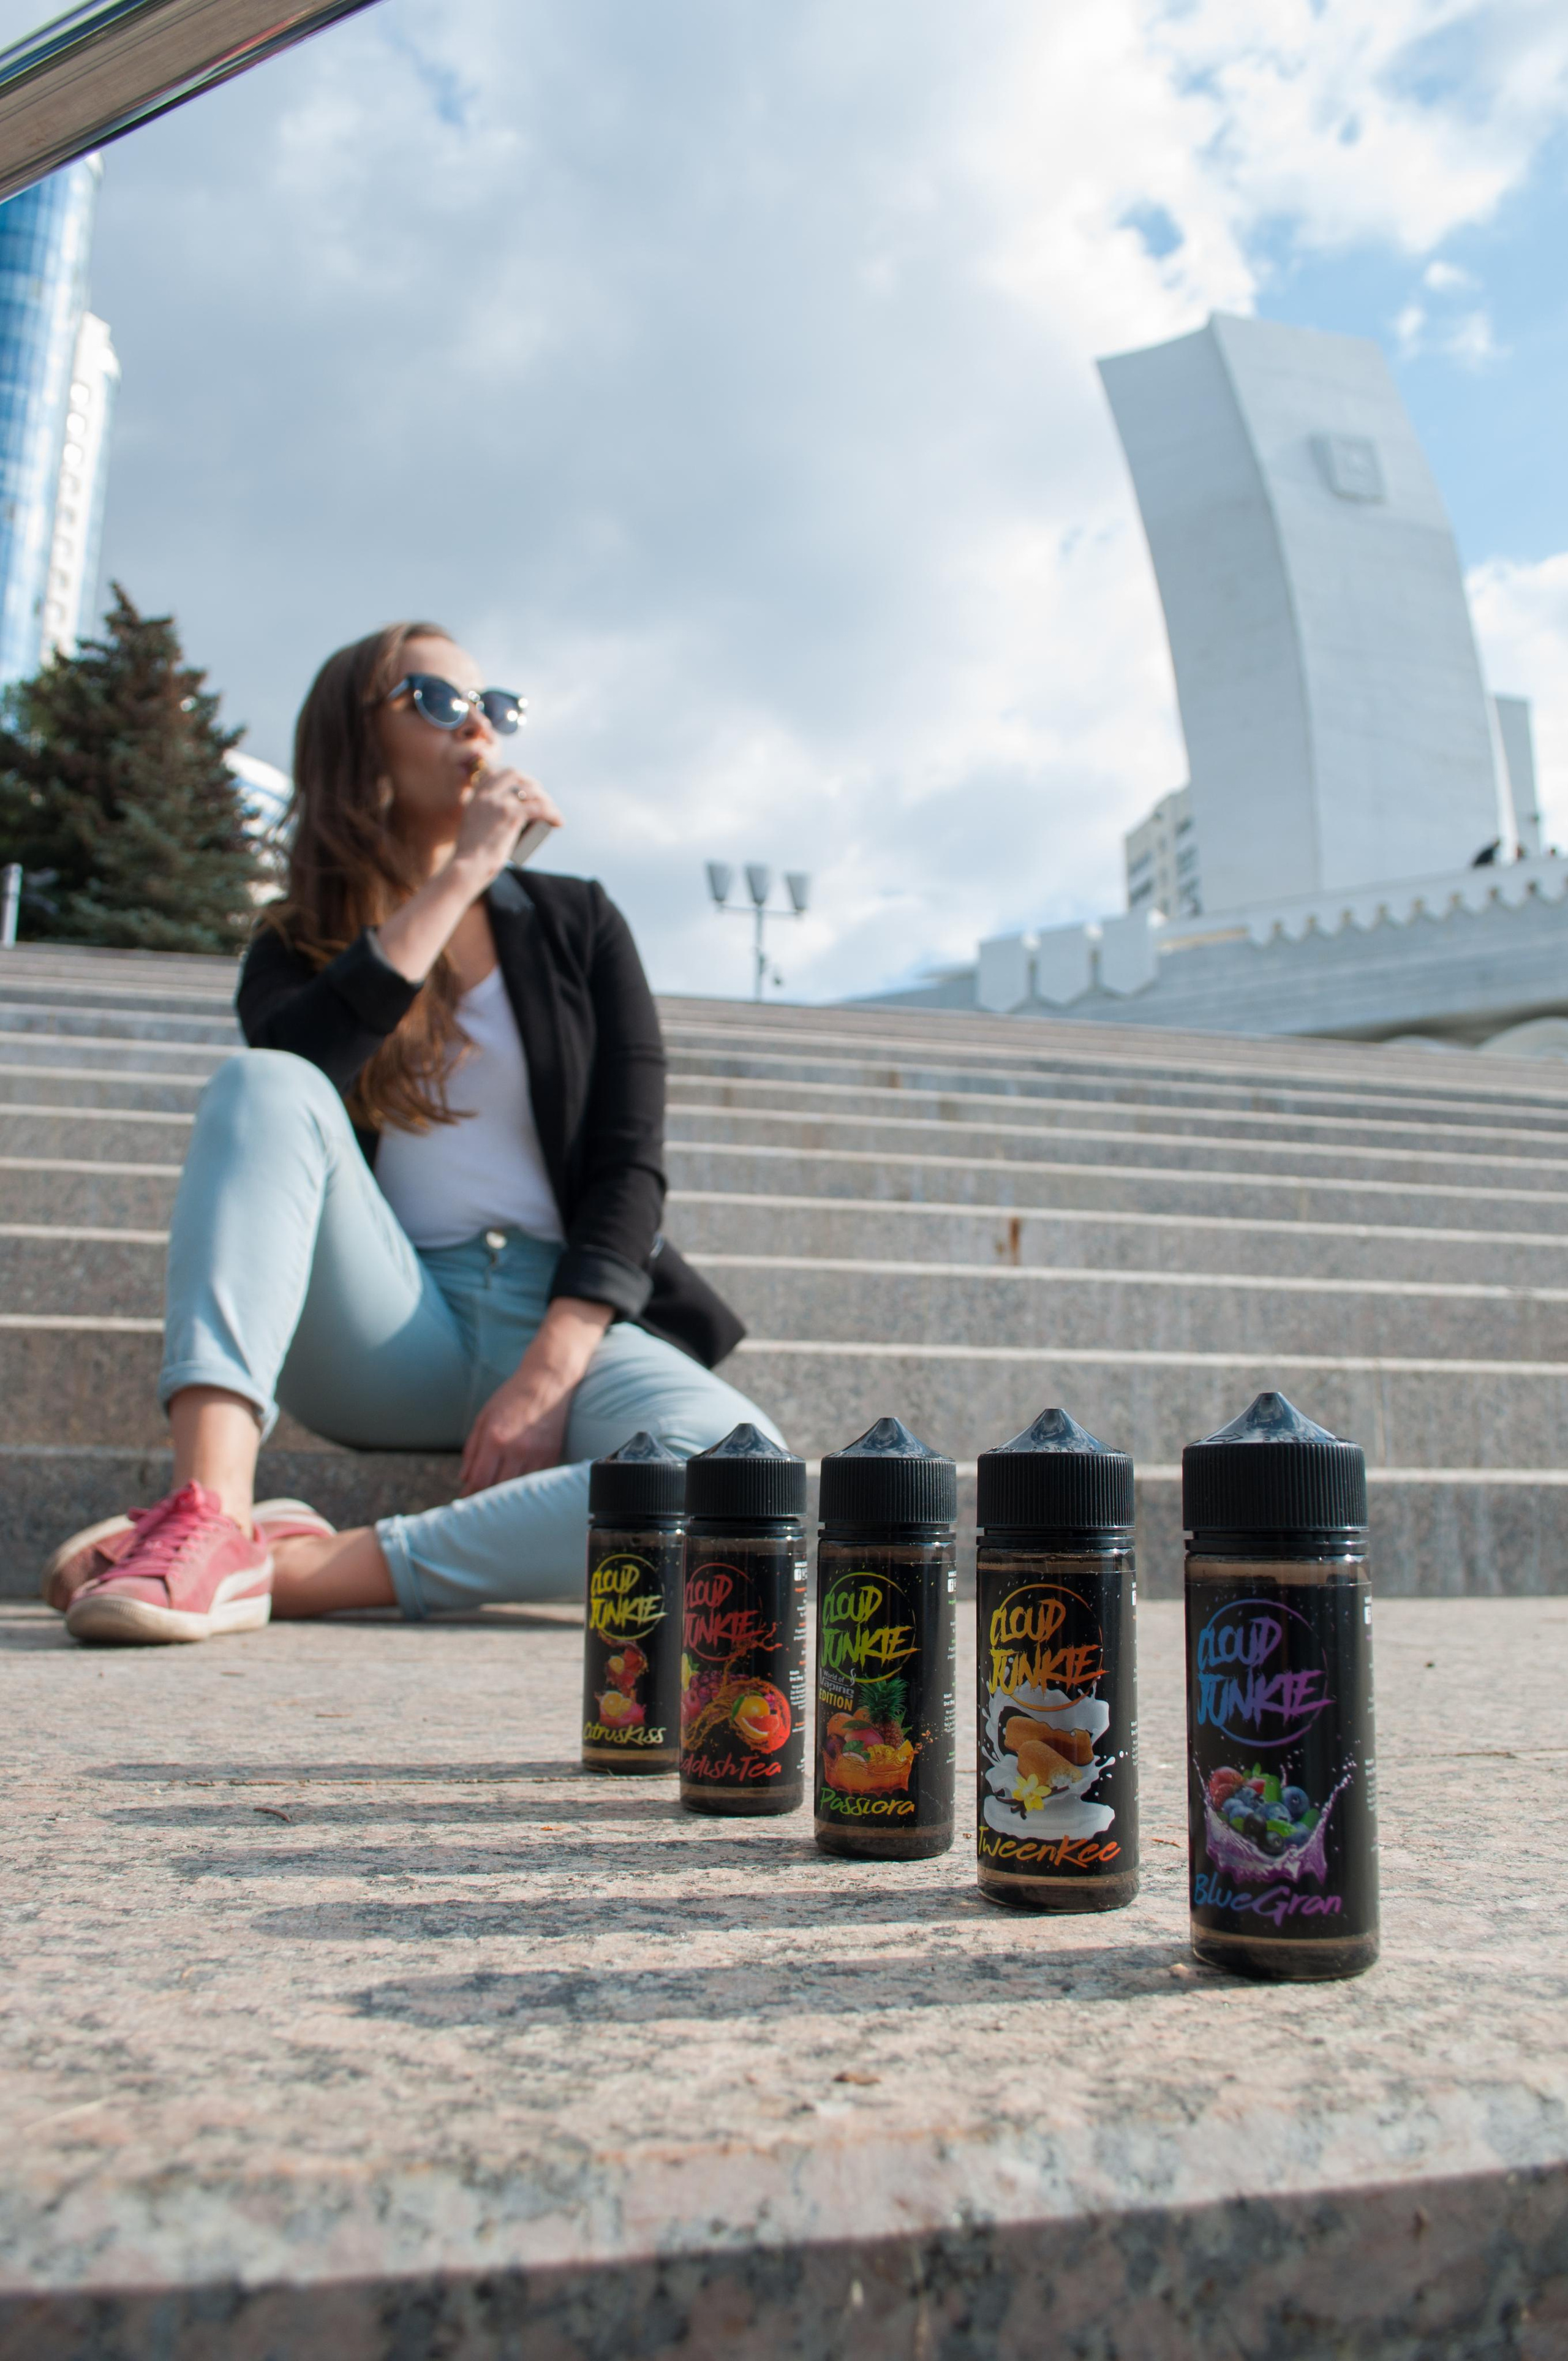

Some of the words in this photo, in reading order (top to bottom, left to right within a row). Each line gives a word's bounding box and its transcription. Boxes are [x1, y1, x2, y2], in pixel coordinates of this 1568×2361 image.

[590, 1564, 640, 1598] CLOUD
[684, 1574, 733, 1611] CLOUD
[589, 1594, 668, 1630] JUNKIE
[823, 1585, 883, 1626] CLOUD
[990, 1598, 1066, 1647] CLOUD
[682, 1607, 766, 1650] JUNKIE
[821, 1623, 922, 1671] JUNKIE
[1197, 1615, 1282, 1671] CLOUD
[820, 1668, 854, 1699] Vaping
[823, 1669, 838, 1681] World
[989, 1642, 1110, 1699] JUNKIE
[819, 1688, 853, 1712] EDITION
[1197, 1666, 1336, 1732] JUNKIE
